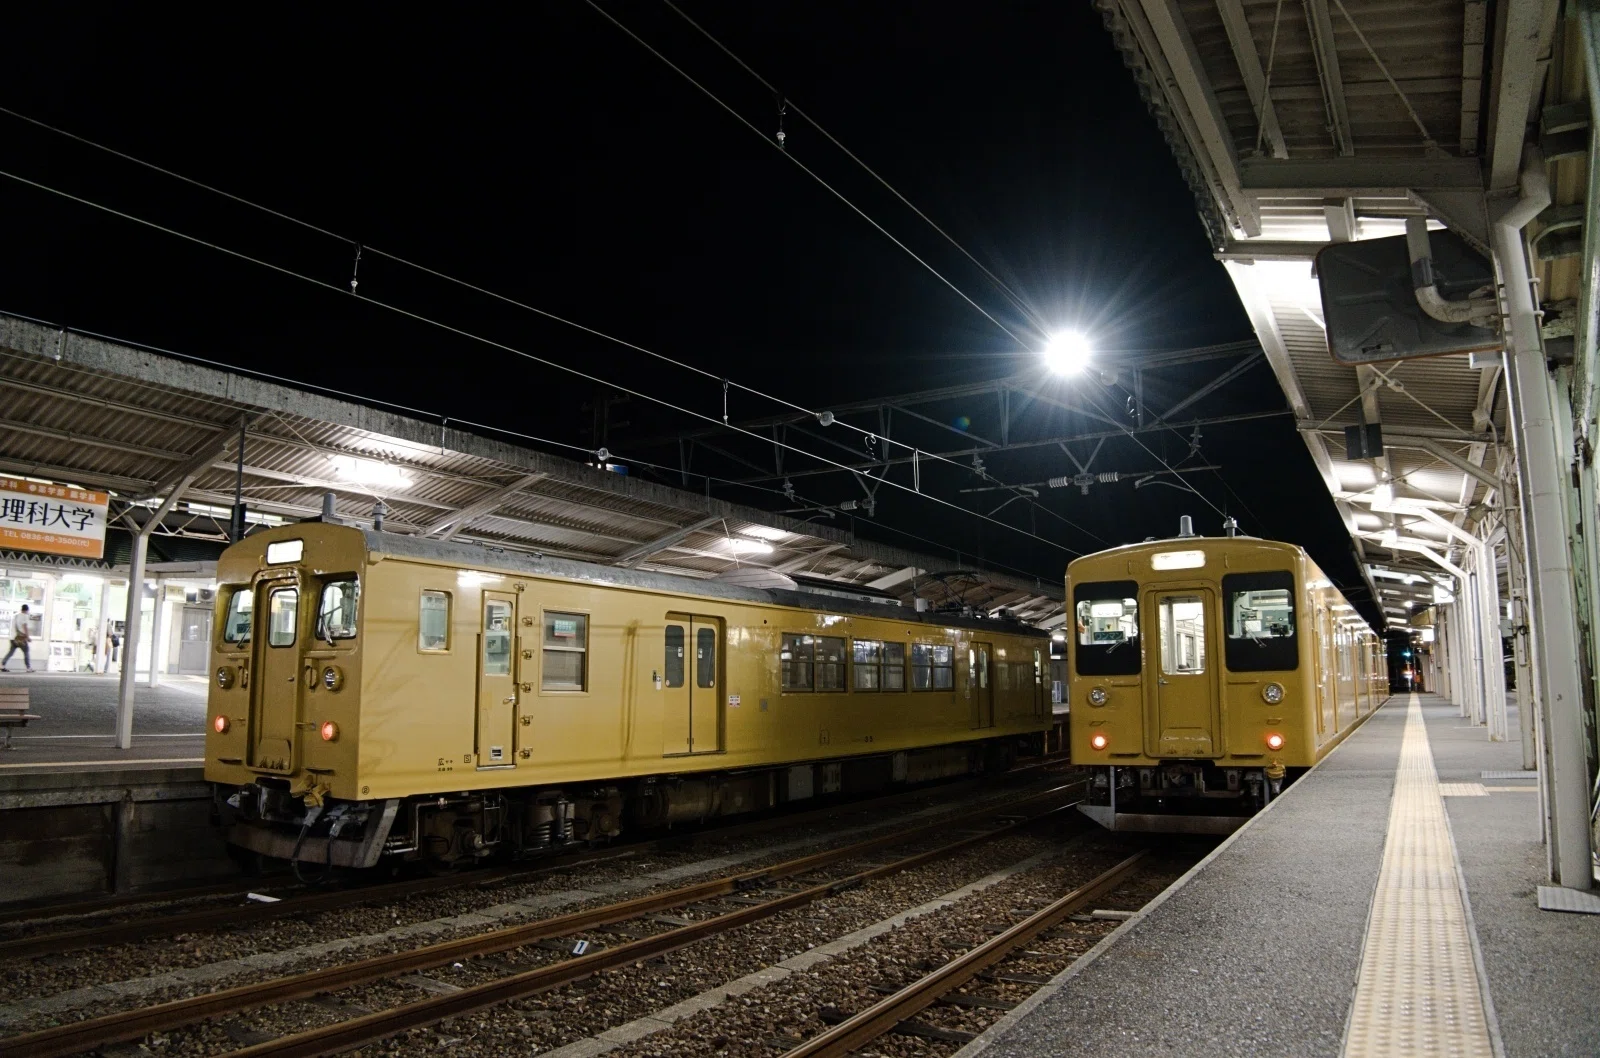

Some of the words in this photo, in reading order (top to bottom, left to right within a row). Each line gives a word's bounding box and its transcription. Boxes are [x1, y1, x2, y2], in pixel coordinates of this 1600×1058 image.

[0, 498, 95, 531] 理科大学
[3, 529, 19, 539] TEL
[577, 941, 585, 952] 1
